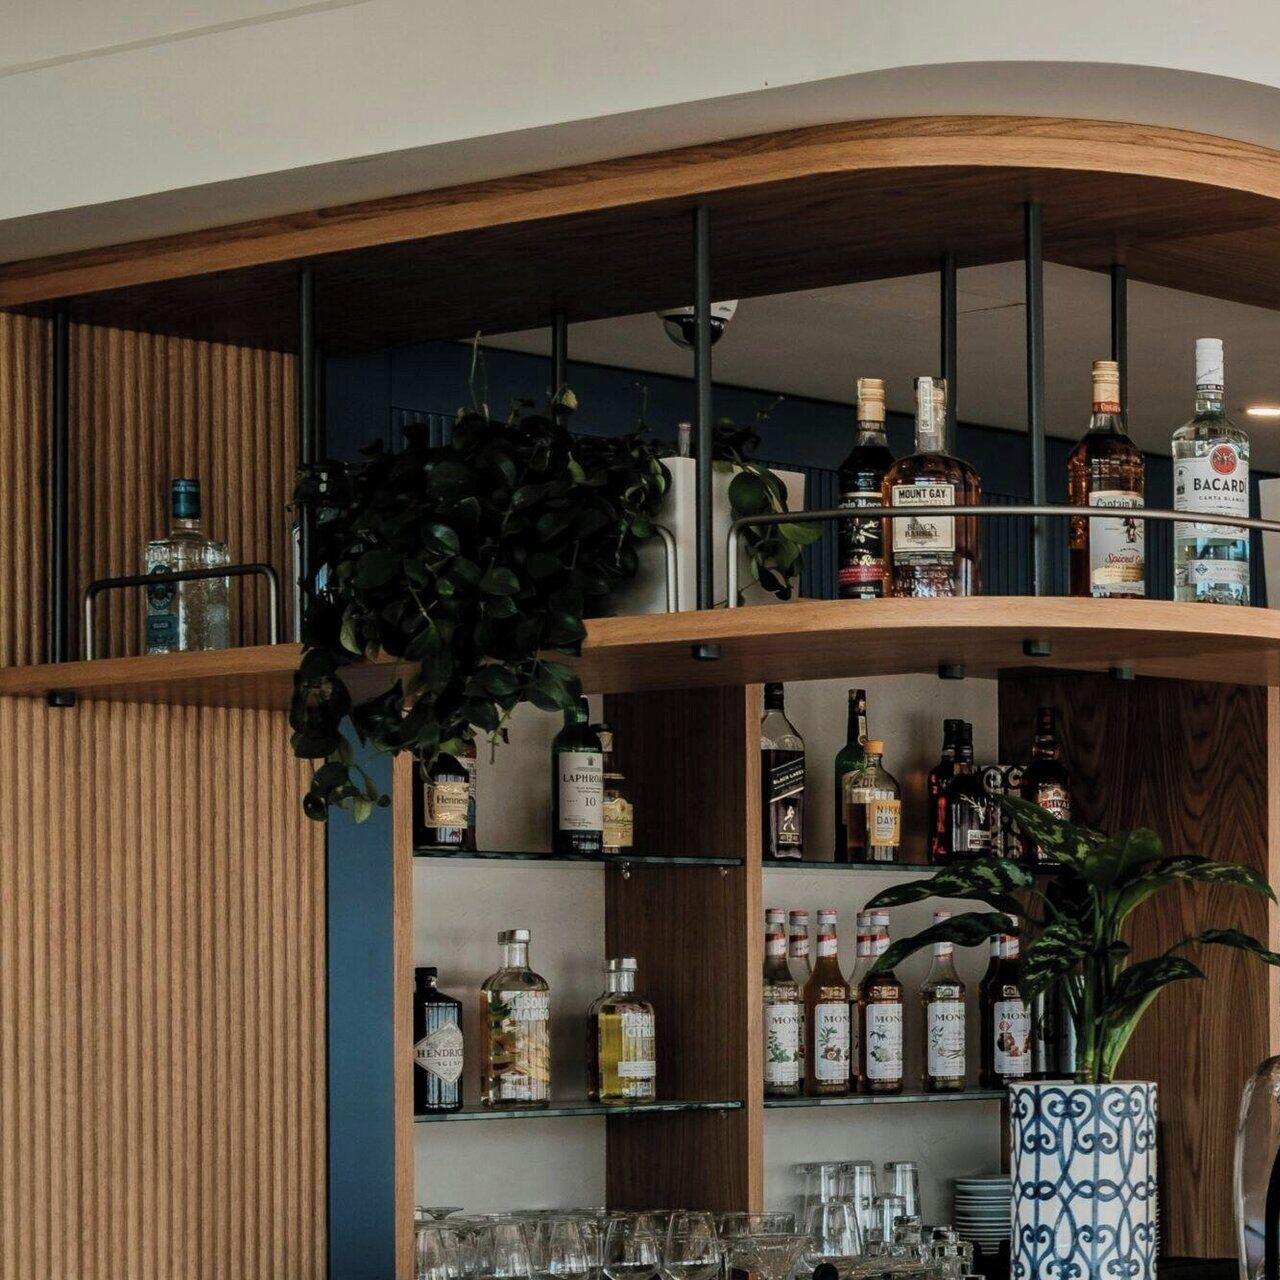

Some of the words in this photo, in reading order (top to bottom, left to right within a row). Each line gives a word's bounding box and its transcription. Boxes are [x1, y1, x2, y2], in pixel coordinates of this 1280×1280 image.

[898, 489, 927, 499] MOUNT
[929, 488, 946, 498] GAY
[907, 522, 937, 531] BLACK
[584, 797, 597, 807] 10
[876, 815, 897, 825] DAYS
